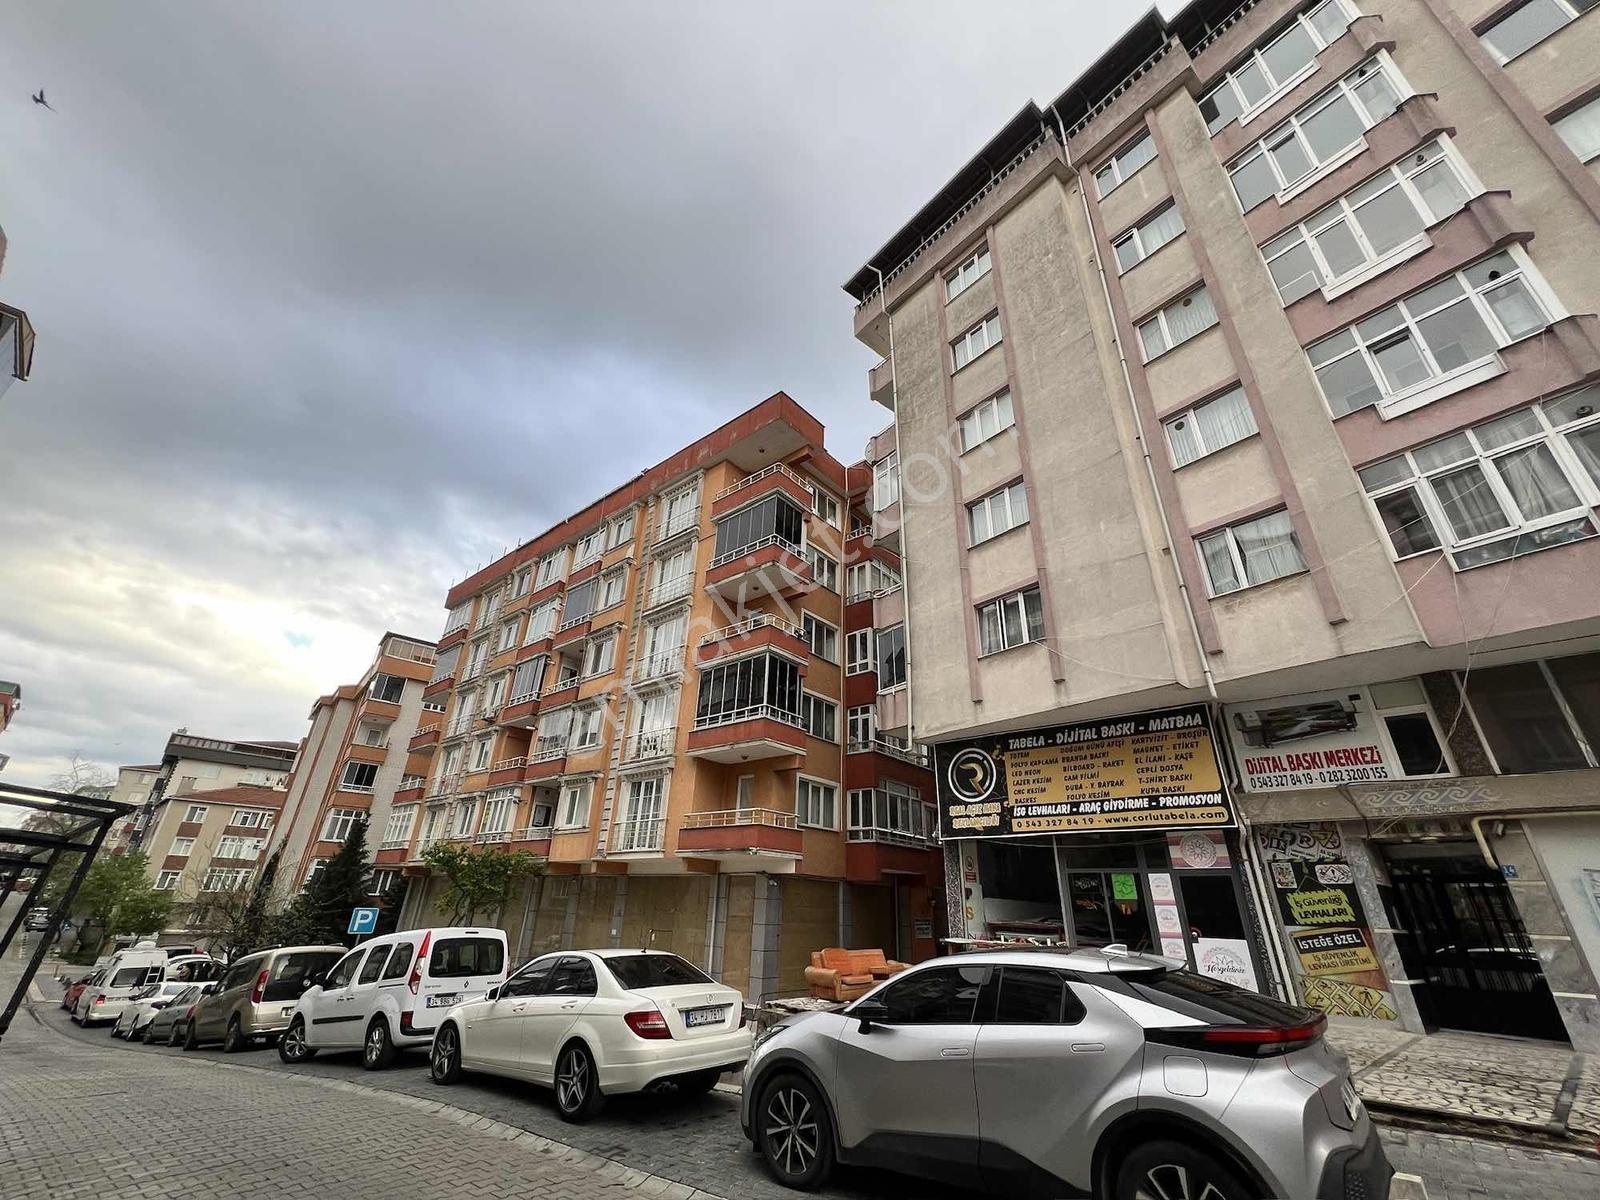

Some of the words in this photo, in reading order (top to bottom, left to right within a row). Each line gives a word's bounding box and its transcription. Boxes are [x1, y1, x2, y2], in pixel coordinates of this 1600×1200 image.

[1008, 735, 1045, 750] TABELA
[1056, 728, 1097, 744] DİJİTAL
[1101, 722, 1134, 738] BASKI
[1149, 713, 1202, 731] MATBAA
[1133, 746, 1163, 754] MAGNET
[1172, 740, 1199, 750] ETİKET
[1010, 752, 1030, 760] TOTEM
[1062, 754, 1087, 763] BRANDA
[1090, 751, 1109, 760] BASKI
[1174, 752, 1194, 760] KAŞE
[1030, 758, 1058, 766] KAPLAMA
[1102, 760, 1124, 768] RAKET
[1286, 752, 1324, 771] BASKI
[1160, 764, 1184, 772] DOSYA
[1032, 776, 1052, 784] KESİM
[1170, 774, 1192, 782] BASKI
[1250, 778, 1256, 788] 0
[1257, 776, 1273, 788] 543
[1273, 775, 1288, 786] 327
[1290, 774, 1302, 785] 84
[1302, 773, 1313, 784] 19
[1320, 772, 1326, 782] 0
[1327, 770, 1345, 782] 282
[1345, 768, 1370, 780] 3200
[1370, 767, 1388, 778] 155
[1098, 780, 1124, 788] BAYRAK
[1162, 785, 1185, 793] BASKI
[1088, 790, 1110, 799] KESİM
[1014, 806, 1026, 816] İSG
[1028, 804, 1070, 816] LEVHALARI
[1079, 801, 1101, 814] ARAÇ
[1104, 798, 1148, 811] GİYDİRME
[1158, 793, 1222, 807] PROMOSYON
[1104, 812, 1226, 824] www.corlutabela.com
[1298, 908, 1348, 919] LEVHALARI
[354, 910, 373, 931] P
[1298, 936, 1334, 949] İSTEĞE
[1334, 934, 1361, 945] ÖZEL
[1322, 950, 1358, 960] GÜVENLİK
[1308, 962, 1338, 970] LEVHASI
